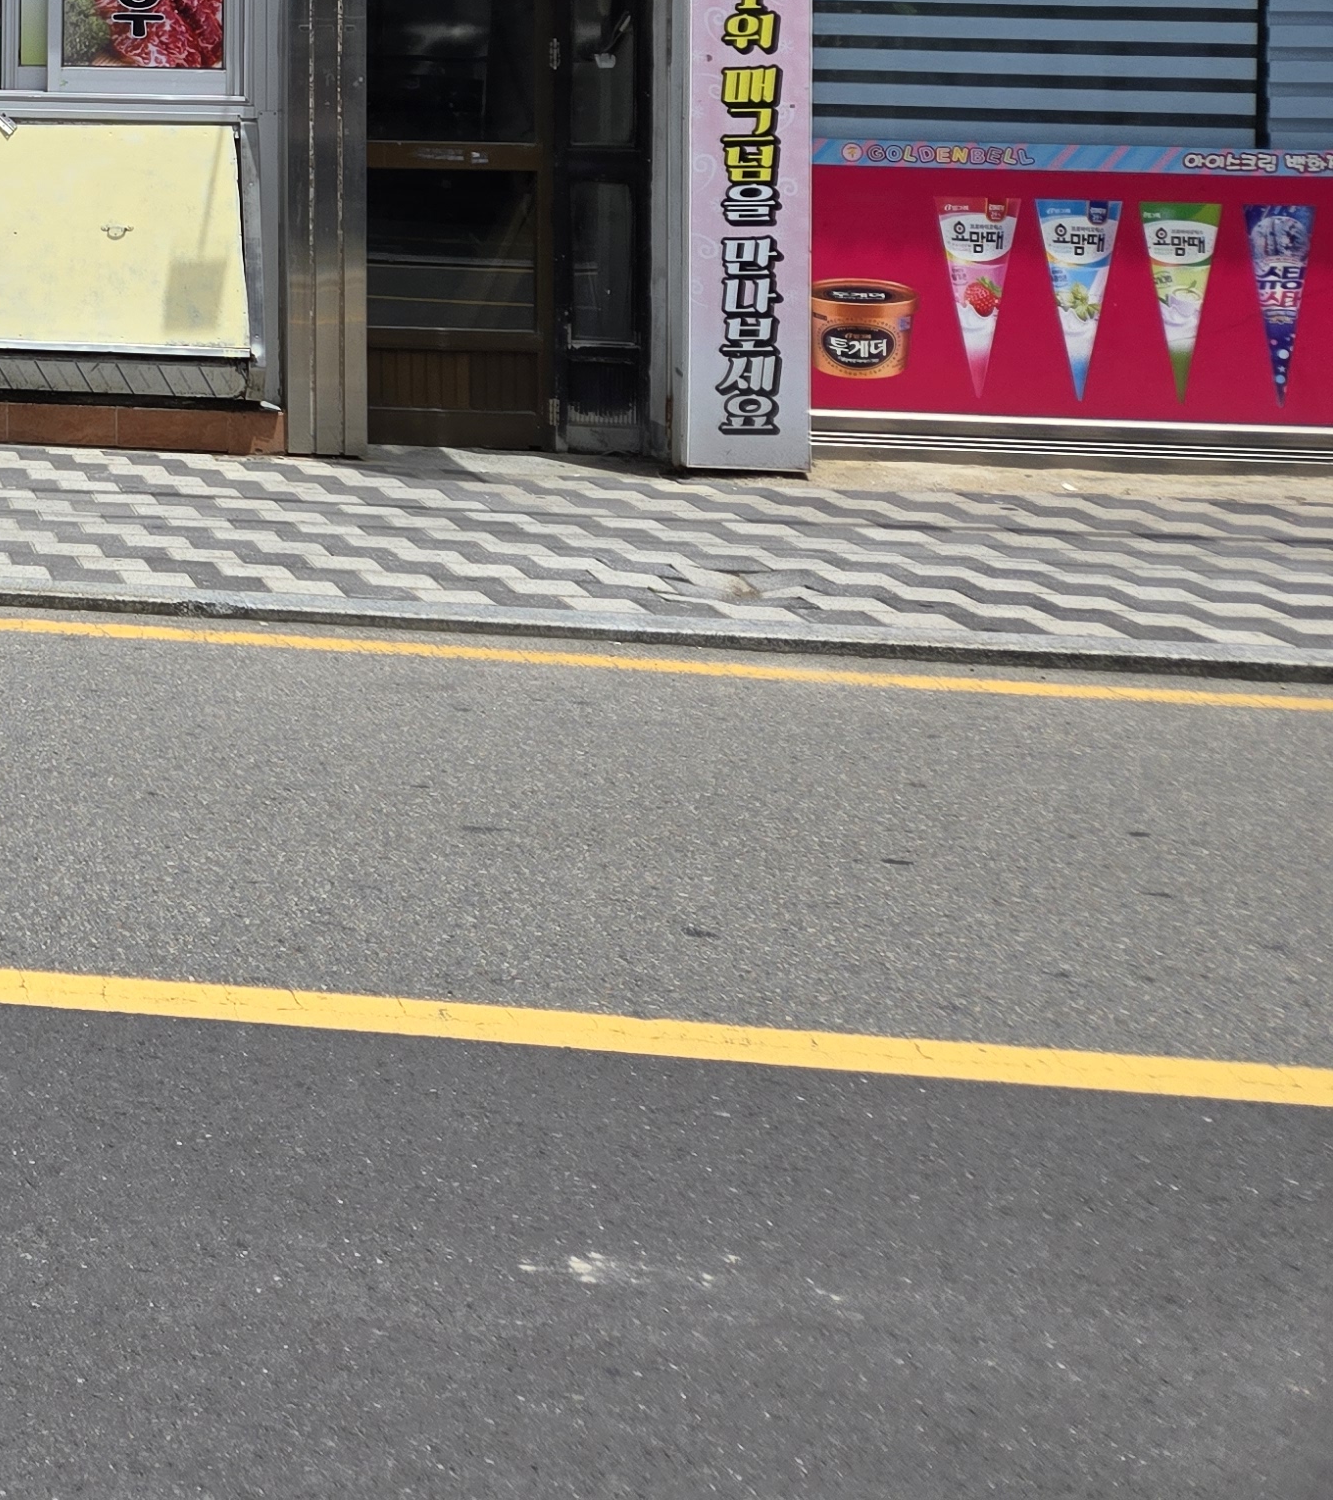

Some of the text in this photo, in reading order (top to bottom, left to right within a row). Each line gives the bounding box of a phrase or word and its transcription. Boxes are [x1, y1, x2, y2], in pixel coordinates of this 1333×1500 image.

[720, 63, 783, 227] 매그넘을
[1184, 152, 1278, 173] 아이스크림
[951, 220, 1004, 254] 요맘때
[1052, 223, 1105, 256] 요맘때
[1152, 227, 1205, 257] 요맘때
[715, 235, 784, 436] 만나보세요
[828, 336, 888, 358] 투게더
